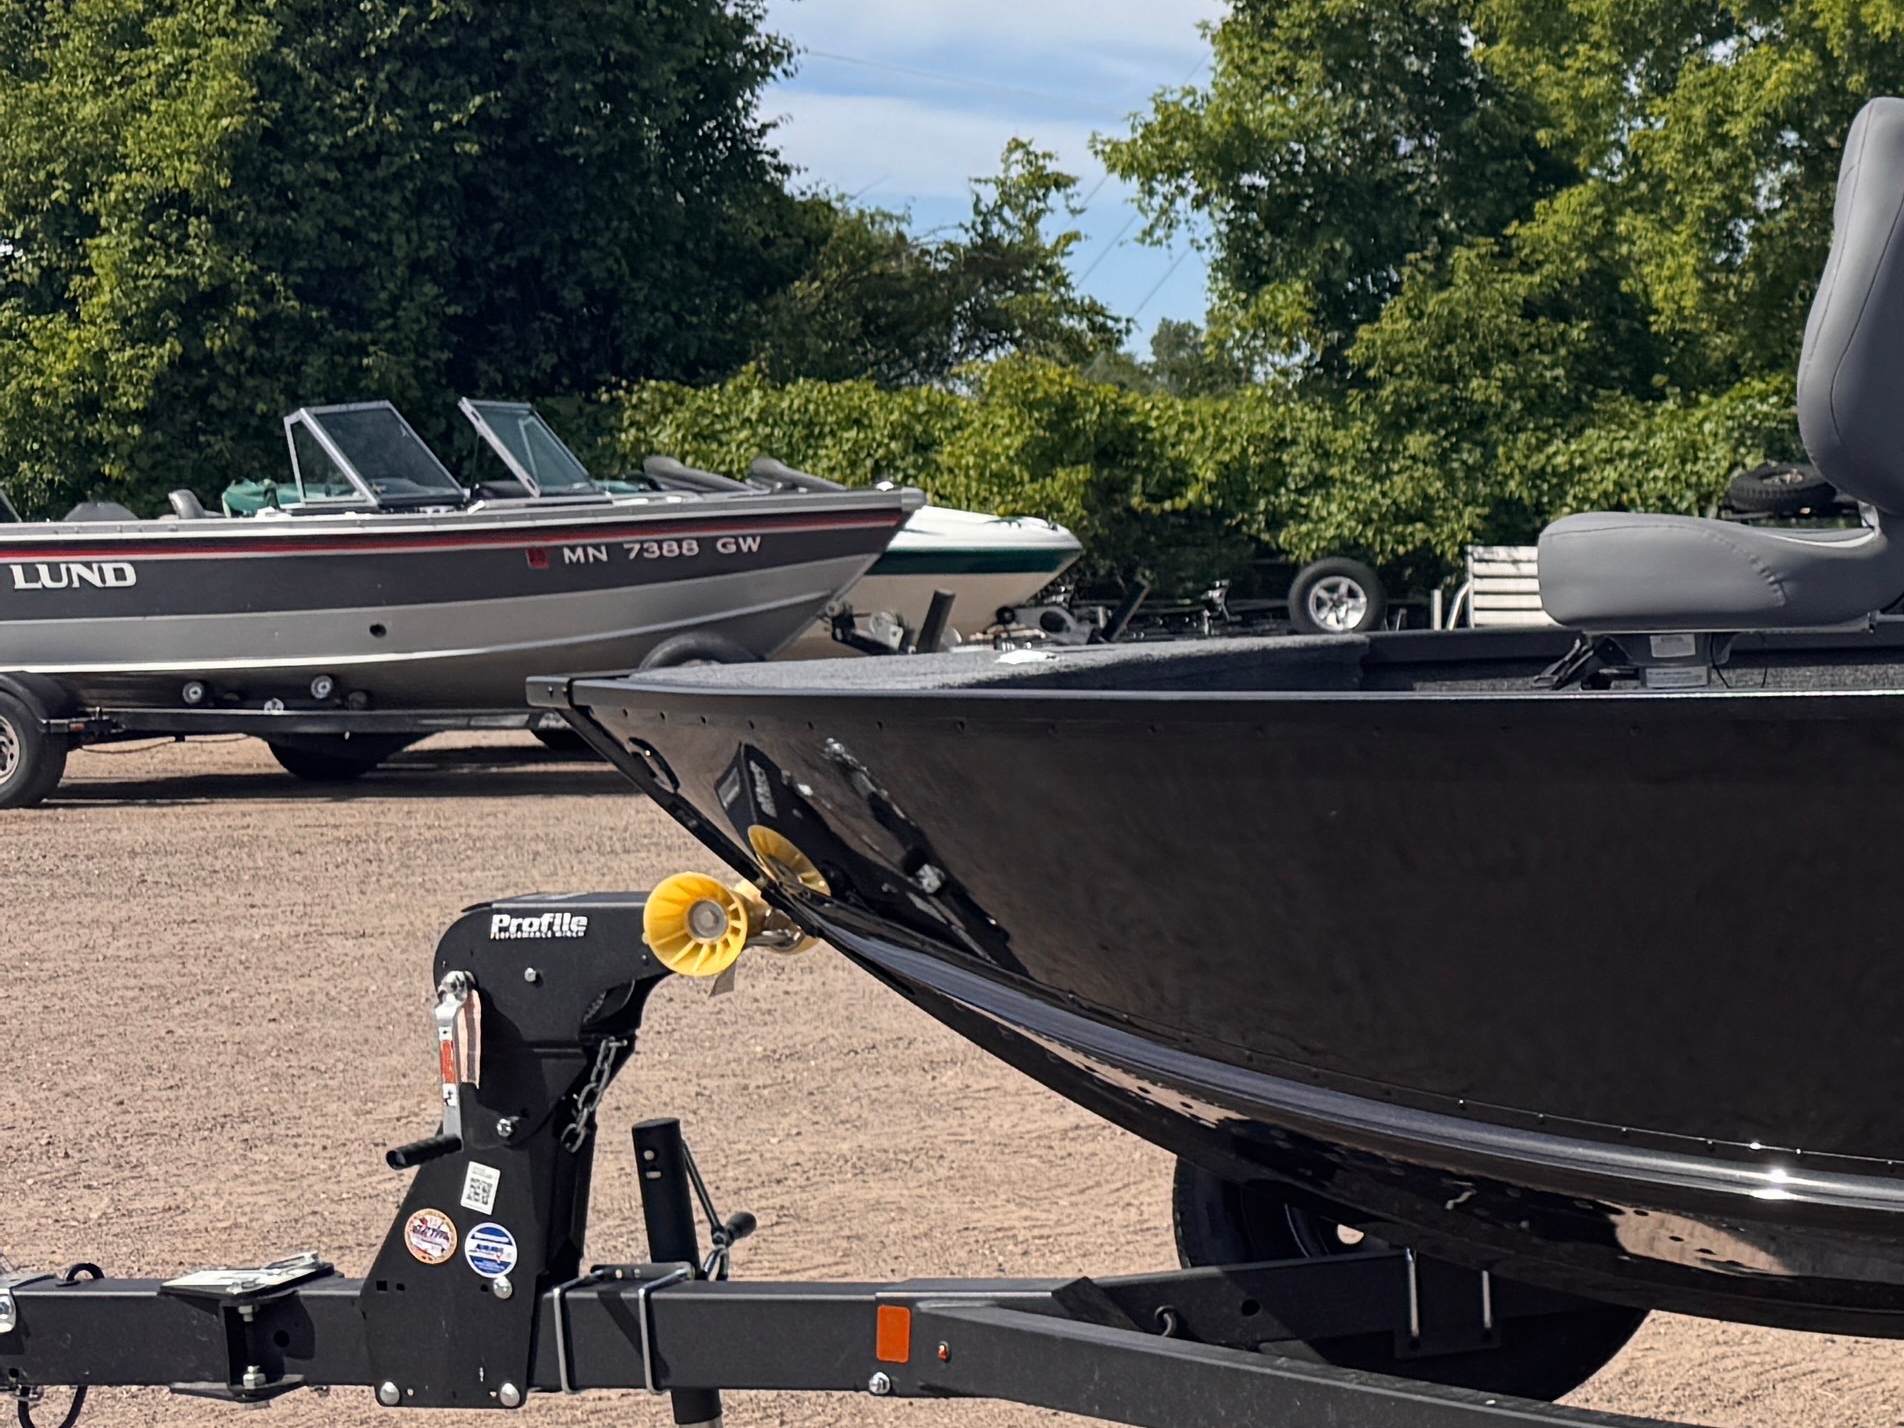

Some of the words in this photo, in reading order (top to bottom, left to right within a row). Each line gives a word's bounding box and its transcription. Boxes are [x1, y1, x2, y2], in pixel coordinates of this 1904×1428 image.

[563, 545, 609, 565] MN
[623, 539, 700, 560] 7388
[716, 536, 761, 553] GW
[9, 562, 137, 589] LUND
[491, 912, 588, 933] Profile
